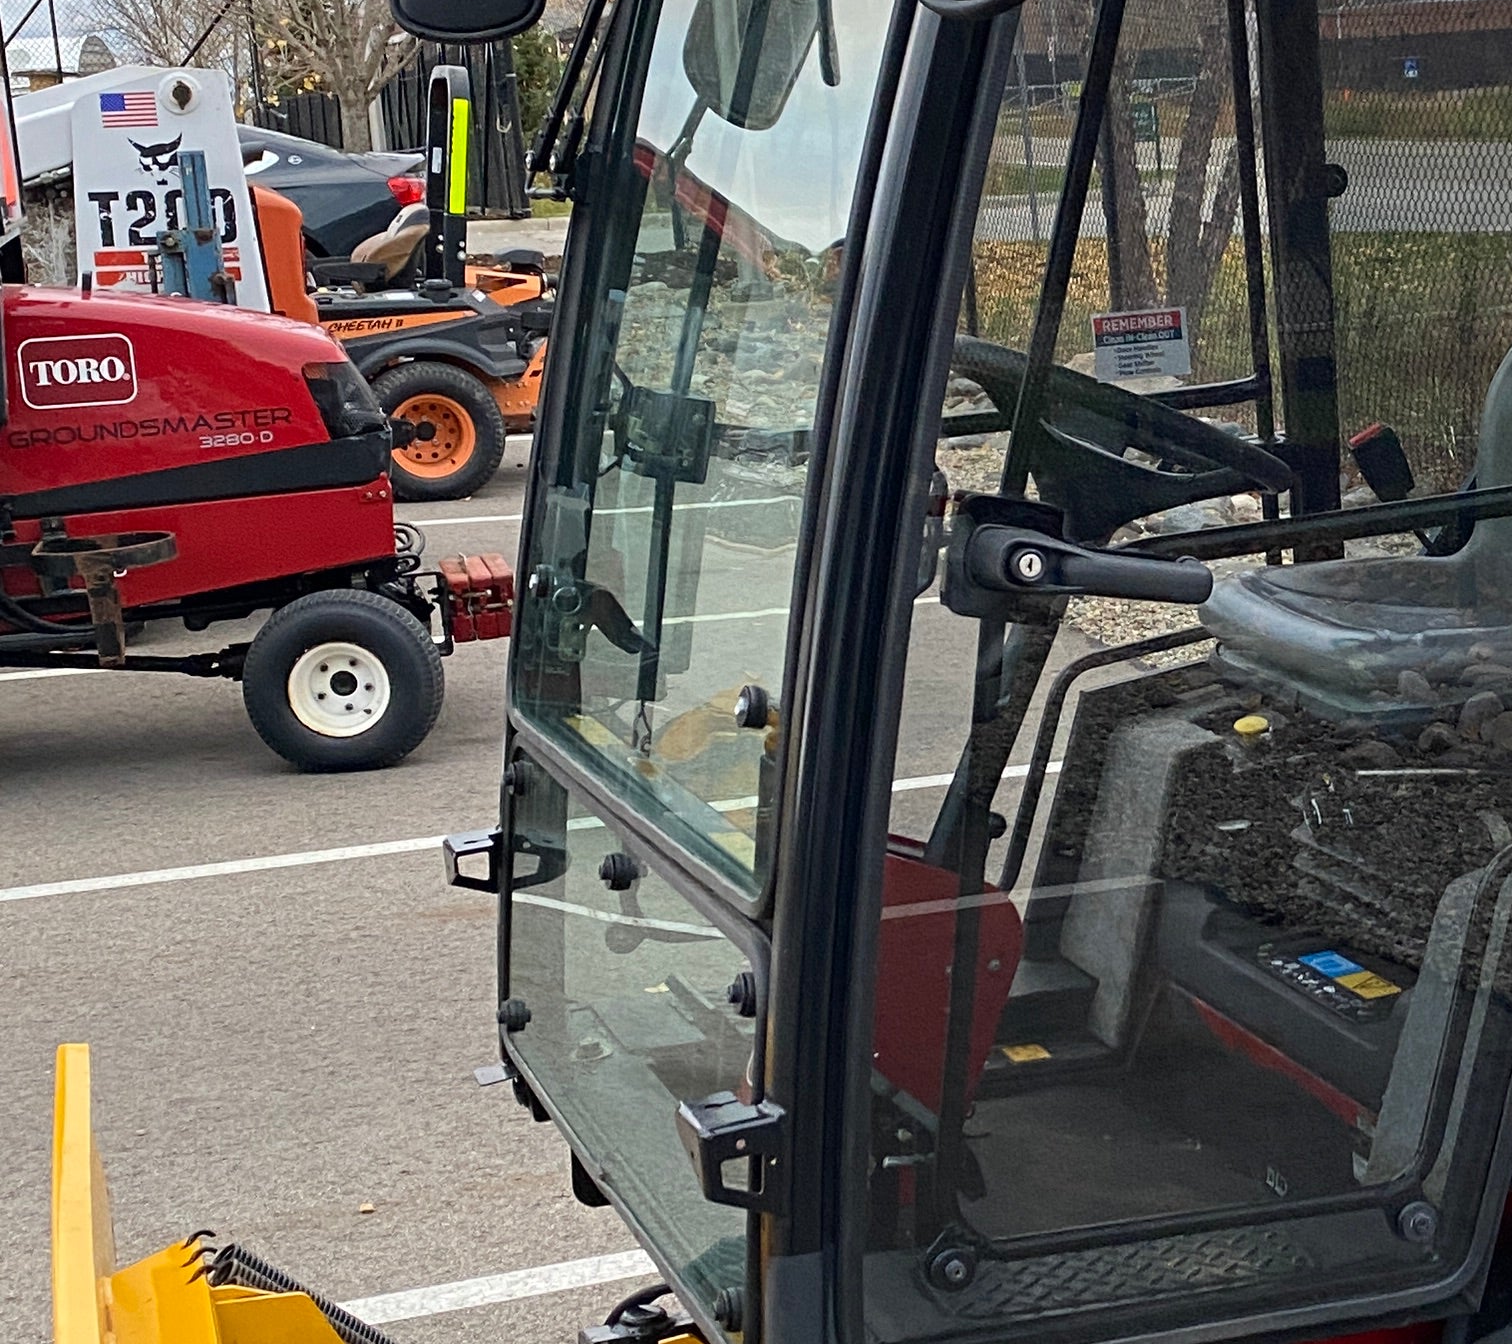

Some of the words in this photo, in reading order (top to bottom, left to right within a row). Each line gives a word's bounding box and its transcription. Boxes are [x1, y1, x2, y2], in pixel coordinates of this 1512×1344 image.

[329, 318, 392, 332] CHEETAH
[1102, 315, 1173, 332] REMEMBER
[29, 356, 126, 387] TORO
[7, 407, 292, 449] GROUNDSMASTER
